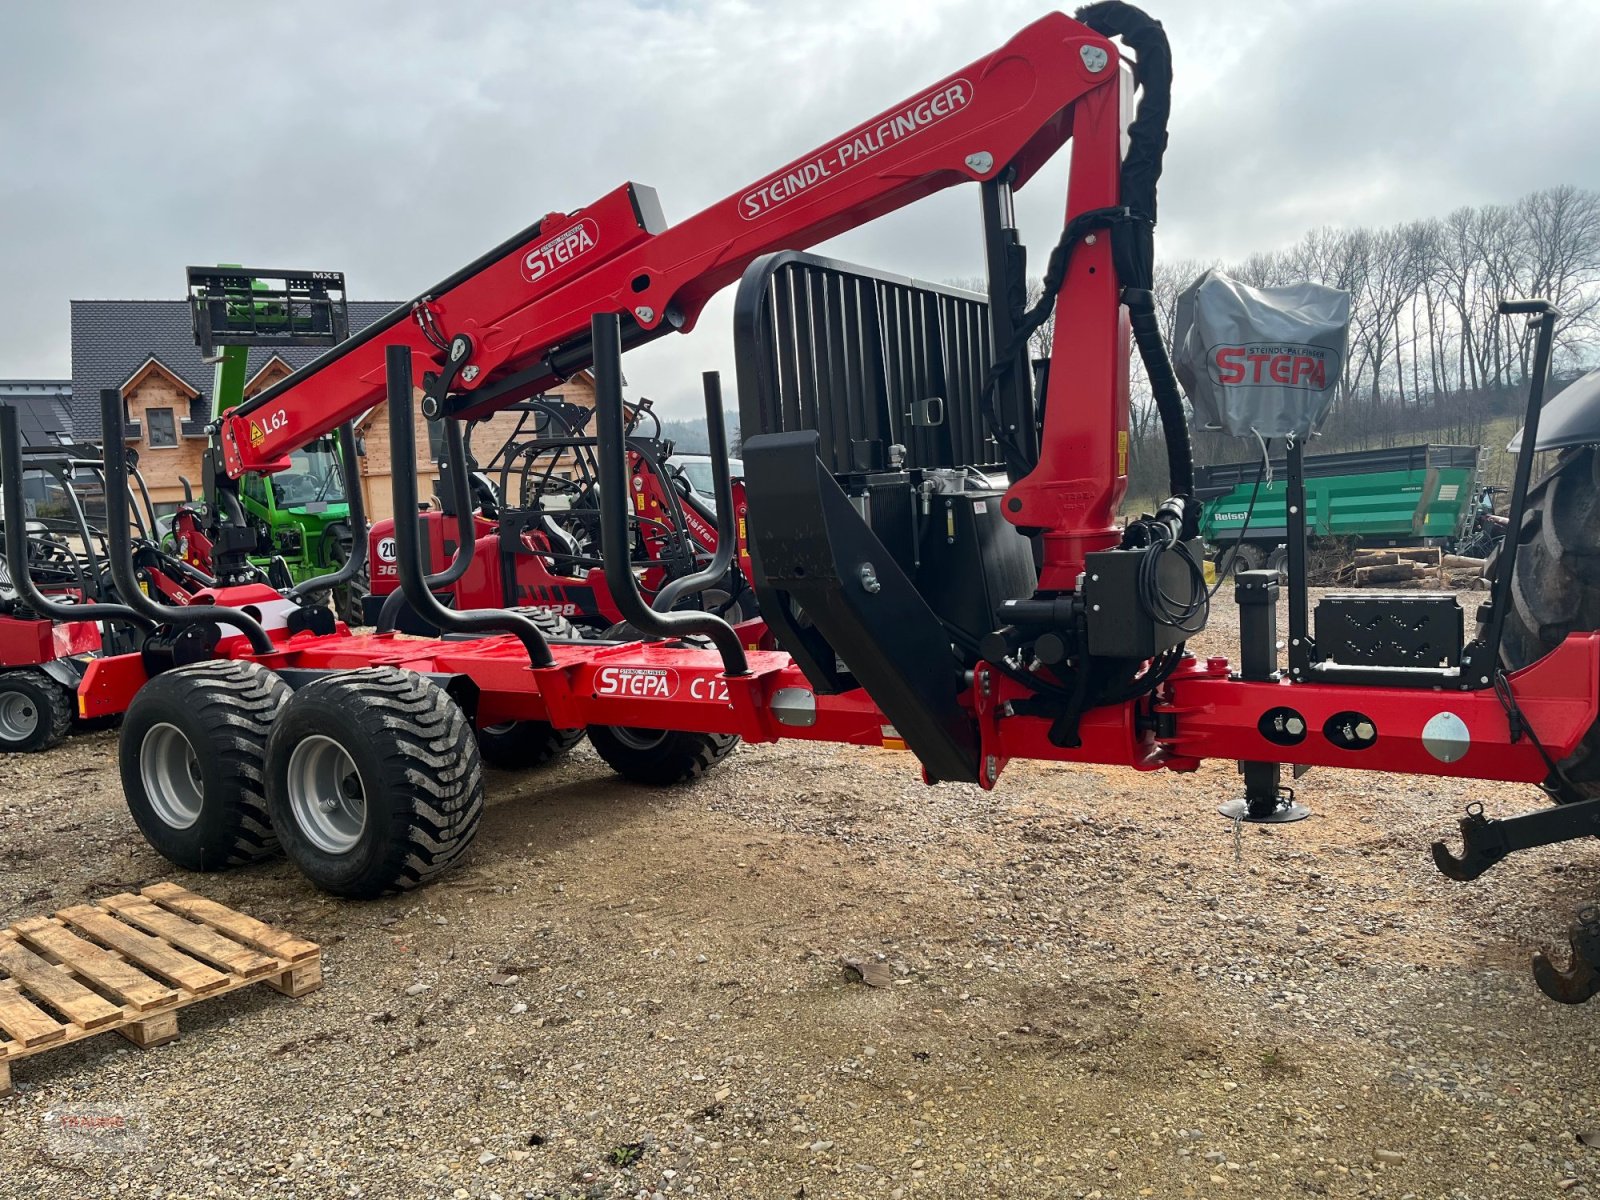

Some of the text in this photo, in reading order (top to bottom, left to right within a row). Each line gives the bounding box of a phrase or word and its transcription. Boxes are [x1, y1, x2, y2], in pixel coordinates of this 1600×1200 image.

[744, 84, 965, 216] STEINDL-PALFINGER
[526, 229, 594, 280] STEPA
[1216, 347, 1326, 388] STEPA
[262, 409, 289, 435] L62
[600, 667, 670, 697] STEPA
